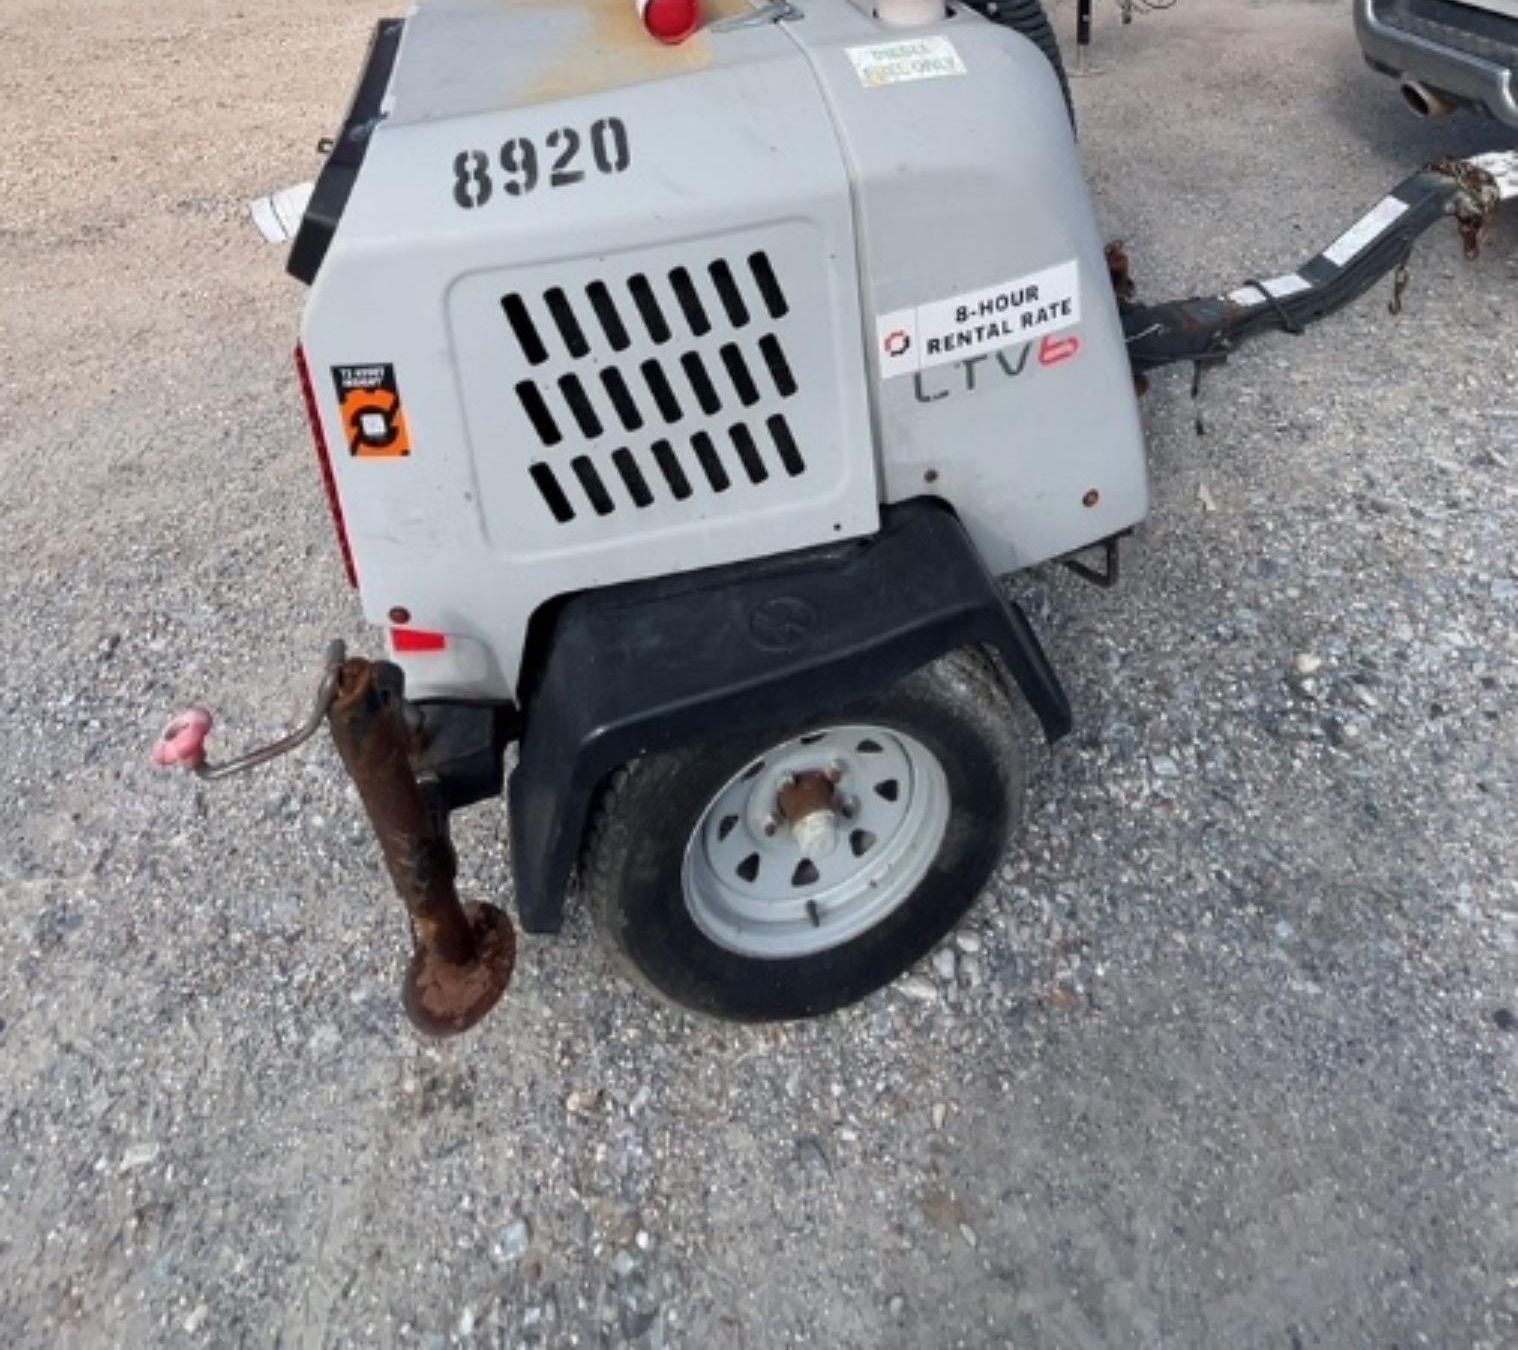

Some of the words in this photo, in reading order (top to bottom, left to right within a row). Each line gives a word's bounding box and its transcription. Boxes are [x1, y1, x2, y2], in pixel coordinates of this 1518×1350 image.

[453, 116, 631, 210] 8920
[927, 321, 1013, 355] RENTAL
[1021, 298, 1072, 329] RATE
[955, 285, 1039, 322] 8-HOUR
[914, 335, 1079, 402] LTV6
